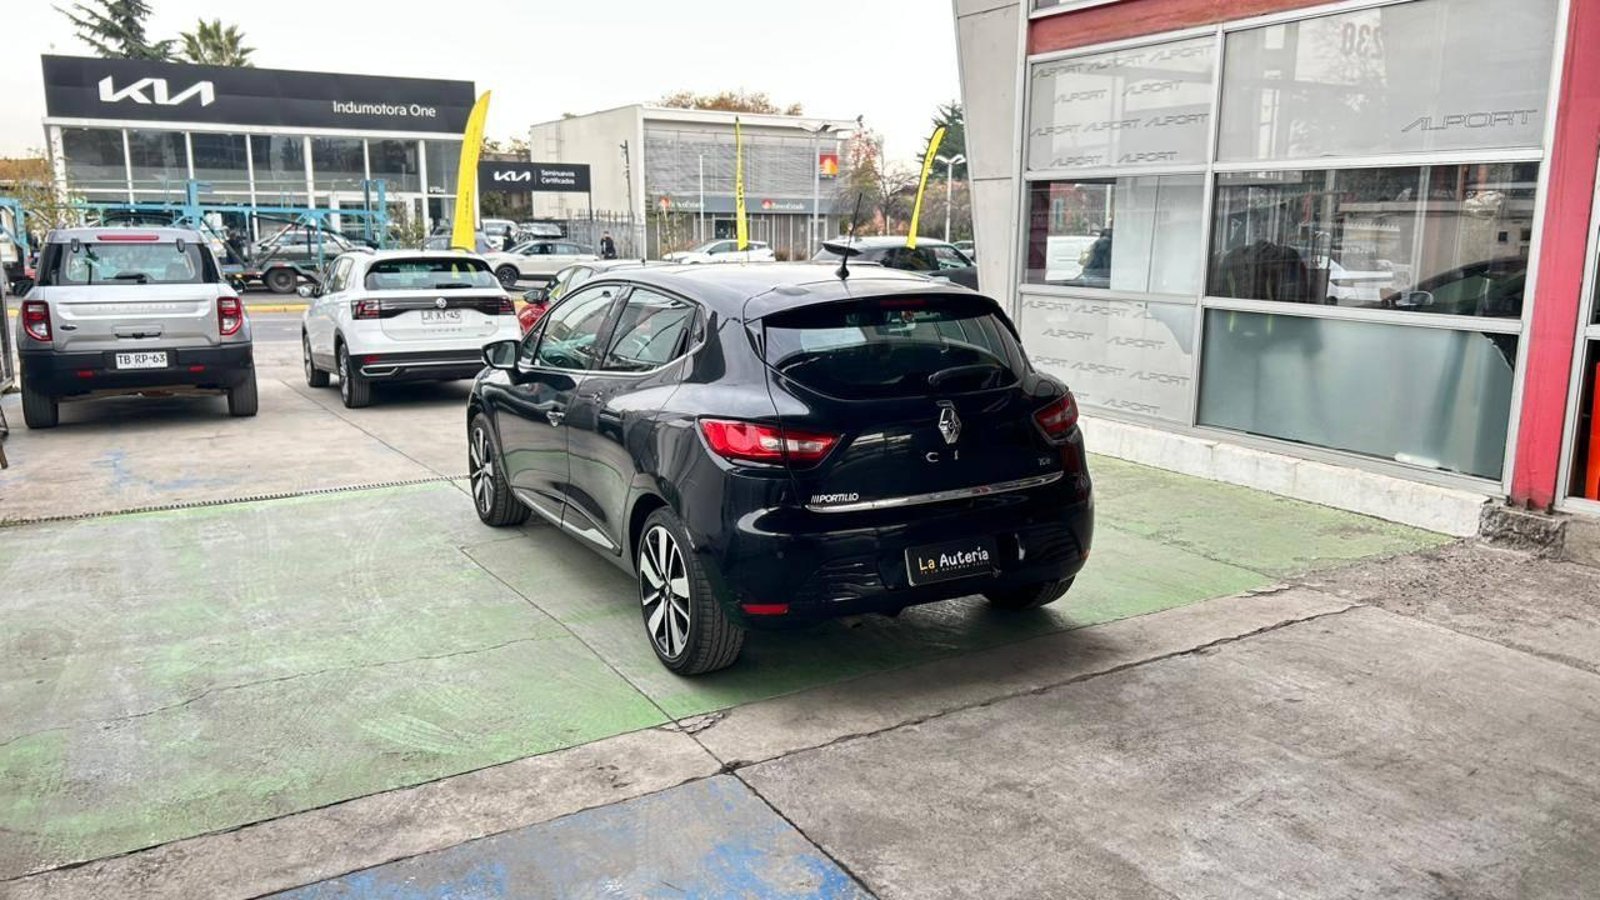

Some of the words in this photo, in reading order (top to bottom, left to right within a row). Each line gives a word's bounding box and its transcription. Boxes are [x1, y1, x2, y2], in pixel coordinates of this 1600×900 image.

[98, 75, 215, 107] KIA
[1122, 79, 1184, 97] ALPORT
[333, 100, 407, 116] Indumotora
[409, 104, 436, 117] One
[1144, 113, 1210, 128] ALPORT
[1400, 109, 1538, 132] ALPORT
[1050, 155, 1103, 167] ALPORT
[1117, 150, 1179, 163] ALPORT
[494, 170, 531, 182] KIA
[1042, 328, 1094, 341] ALPORT
[1106, 336, 1167, 350] ALPORT
[1070, 361, 1127, 376] ALPORT
[1129, 371, 1190, 386] ALPORT
[1102, 399, 1161, 414] ALPORT
[918, 556, 936, 571] La
[939, 546, 990, 567] Autería
